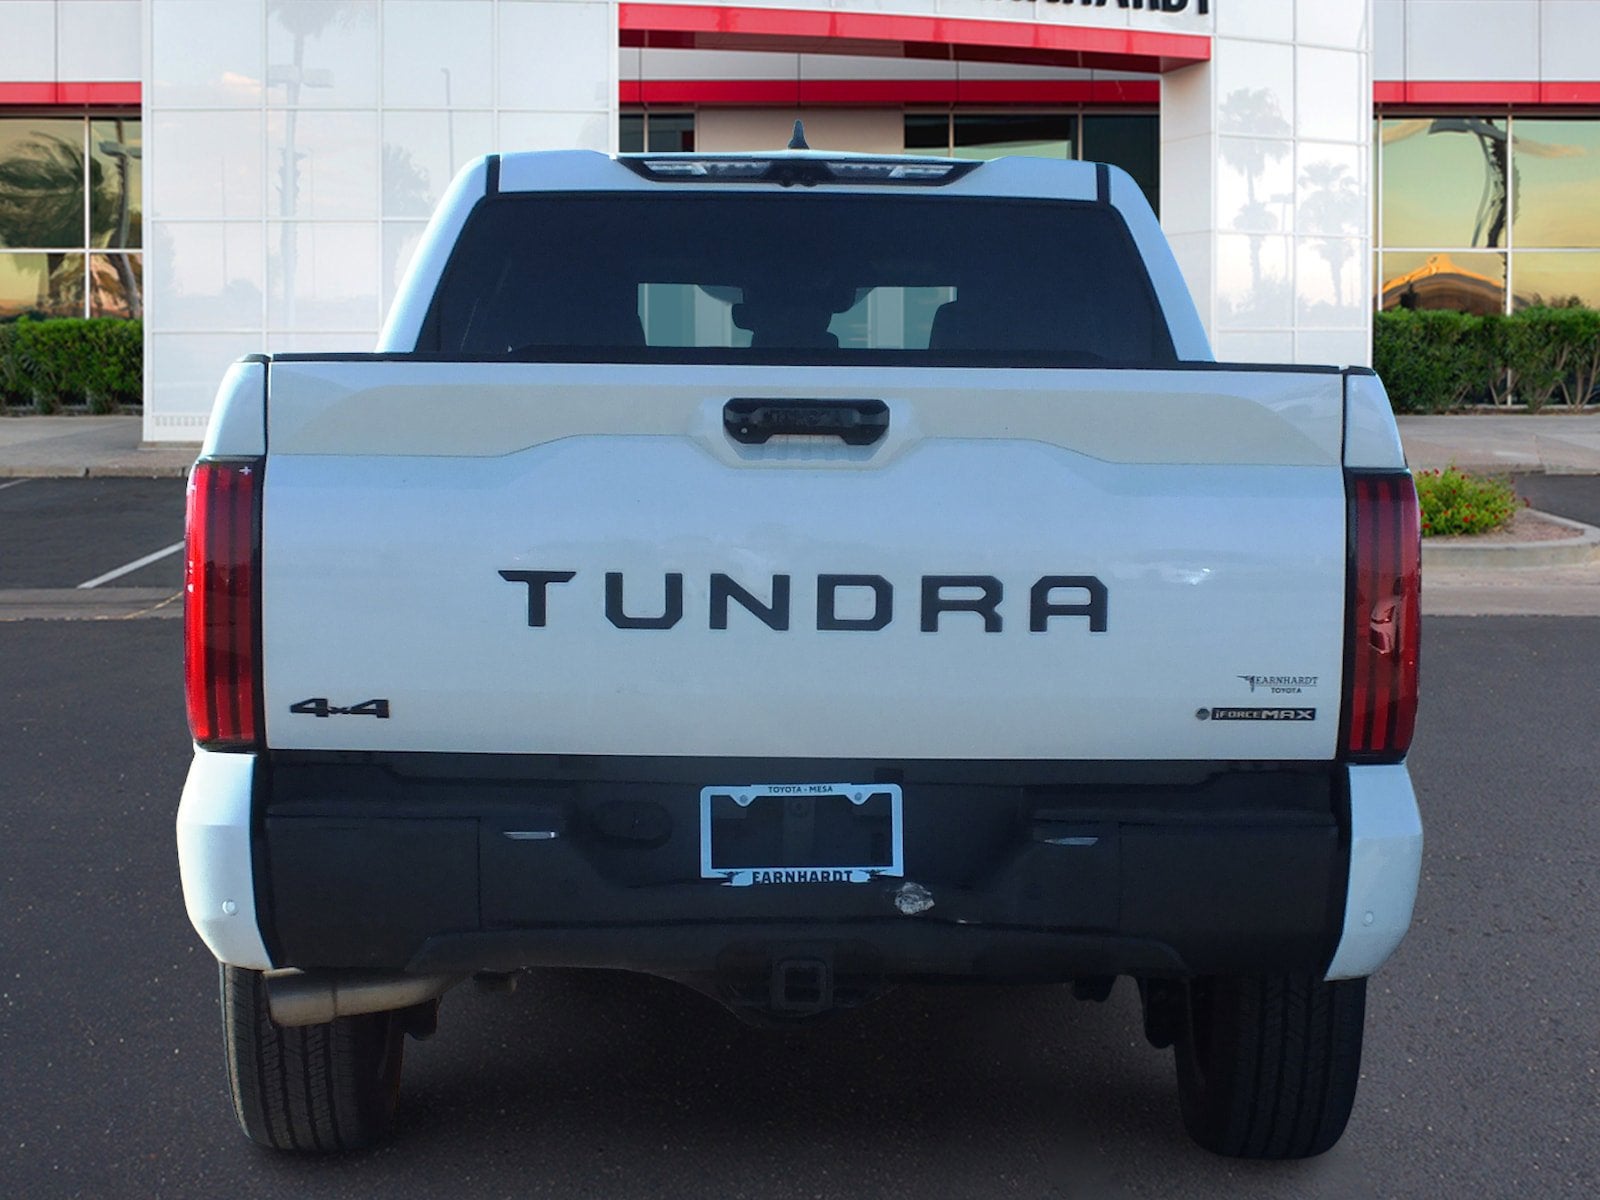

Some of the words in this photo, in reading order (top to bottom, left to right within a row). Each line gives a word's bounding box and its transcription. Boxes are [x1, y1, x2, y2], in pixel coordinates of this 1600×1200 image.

[498, 570, 1109, 632] TUNDRA
[1255, 675, 1319, 686] EARNHARDT
[1270, 686, 1303, 695] TOYOTA
[767, 786, 802, 794] TOYOTA
[809, 785, 834, 793] MESA
[752, 871, 853, 885] EARNHARDT
